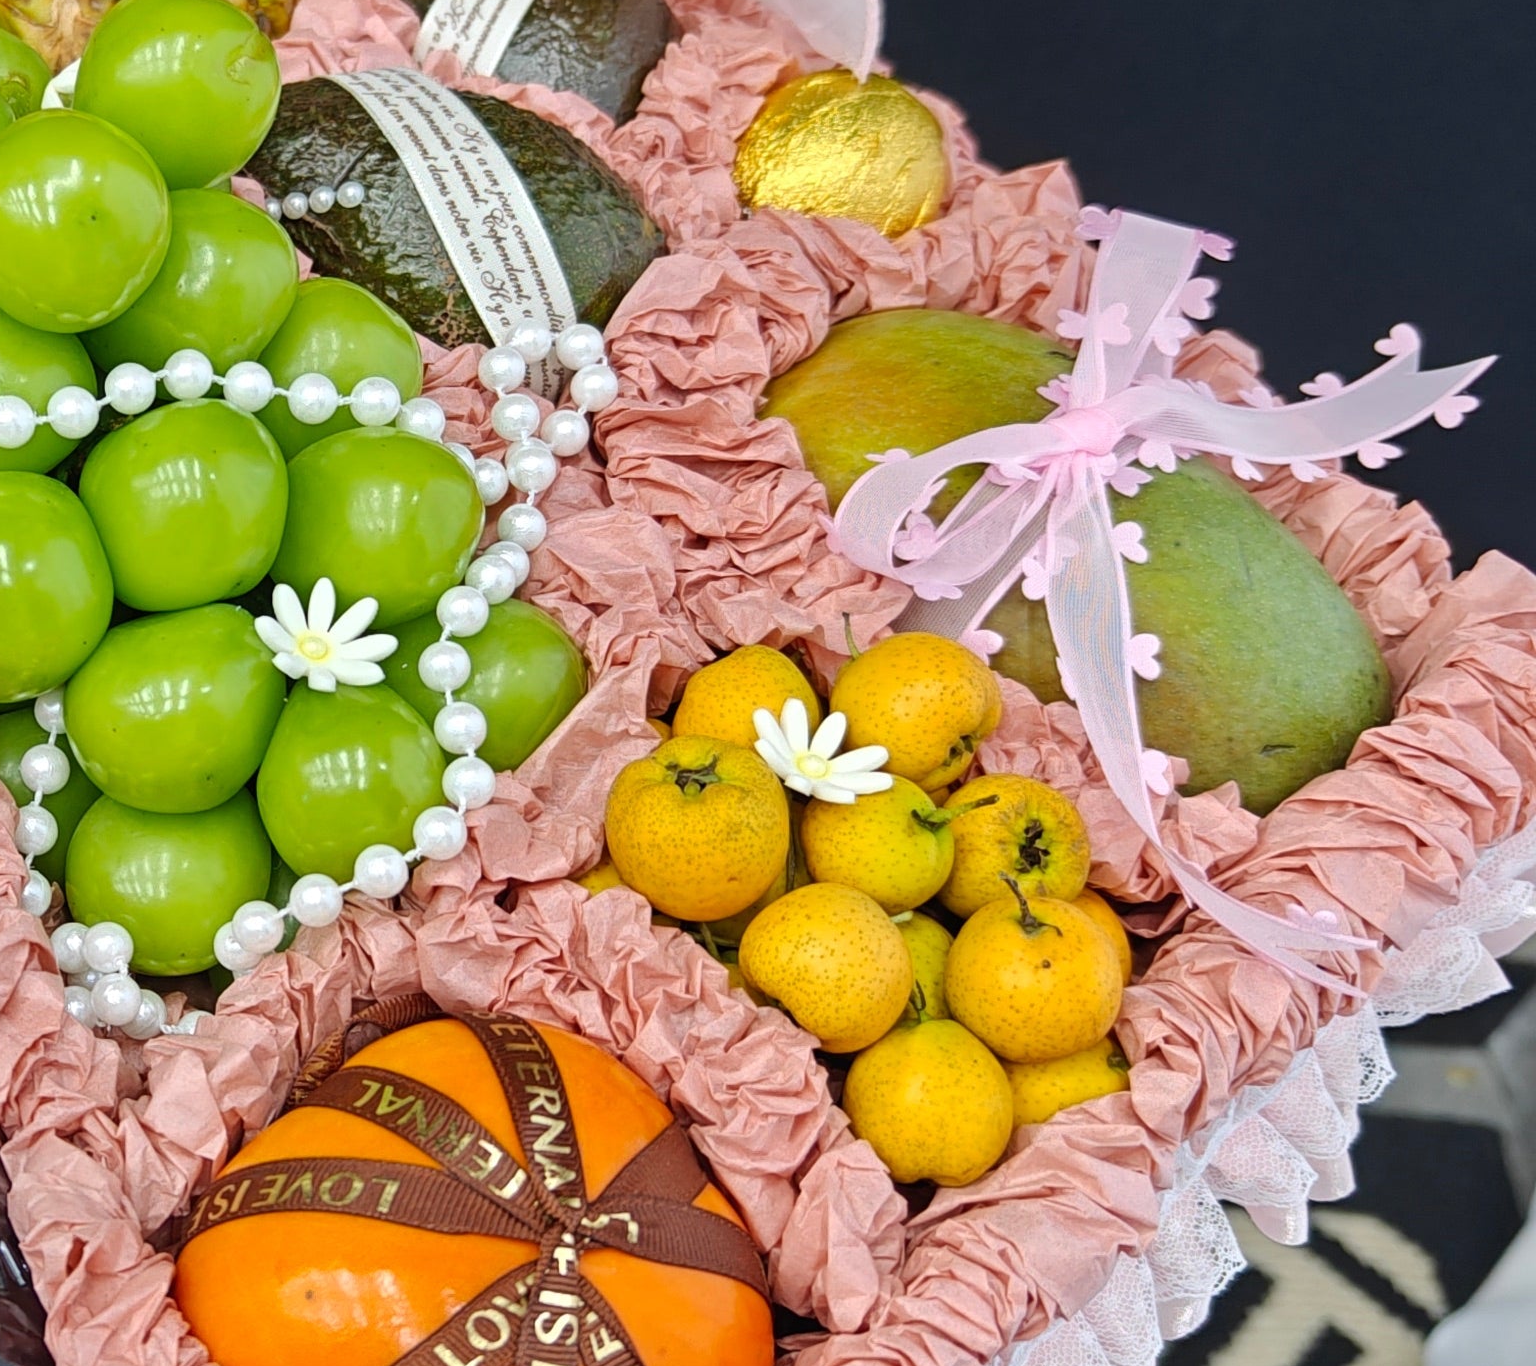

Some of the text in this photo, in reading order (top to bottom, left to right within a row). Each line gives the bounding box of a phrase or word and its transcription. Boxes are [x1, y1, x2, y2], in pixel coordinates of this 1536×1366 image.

[427, 164, 451, 197] dans
[207, 1179, 252, 1223] IS
[251, 1170, 402, 1215] LOVE
[534, 1289, 585, 1347] IS
